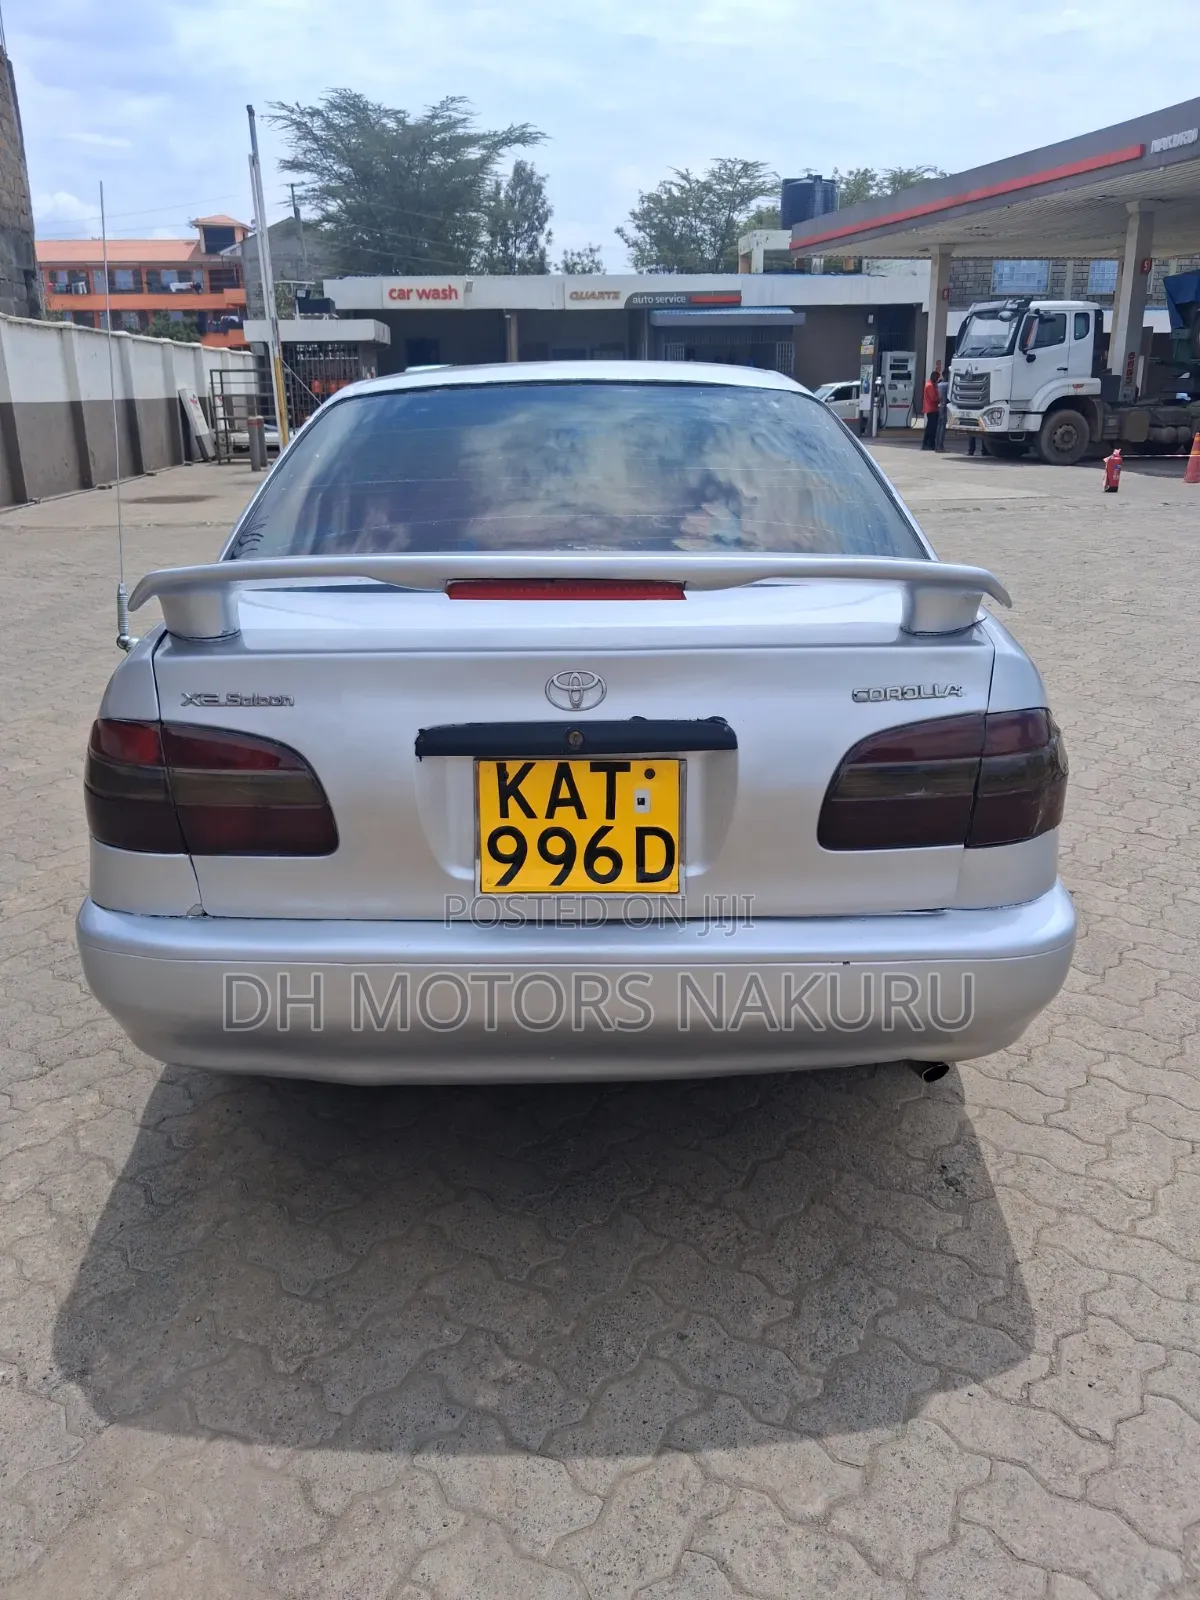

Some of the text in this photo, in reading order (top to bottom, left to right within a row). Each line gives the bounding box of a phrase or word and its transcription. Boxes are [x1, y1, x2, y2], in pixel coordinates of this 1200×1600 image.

[388, 284, 459, 301] car wash
[569, 291, 621, 301] QUARTZ
[632, 294, 686, 304] auto service
[851, 683, 964, 703] COROLLA
[496, 761, 631, 820] KAT
[487, 825, 676, 886] 996D
